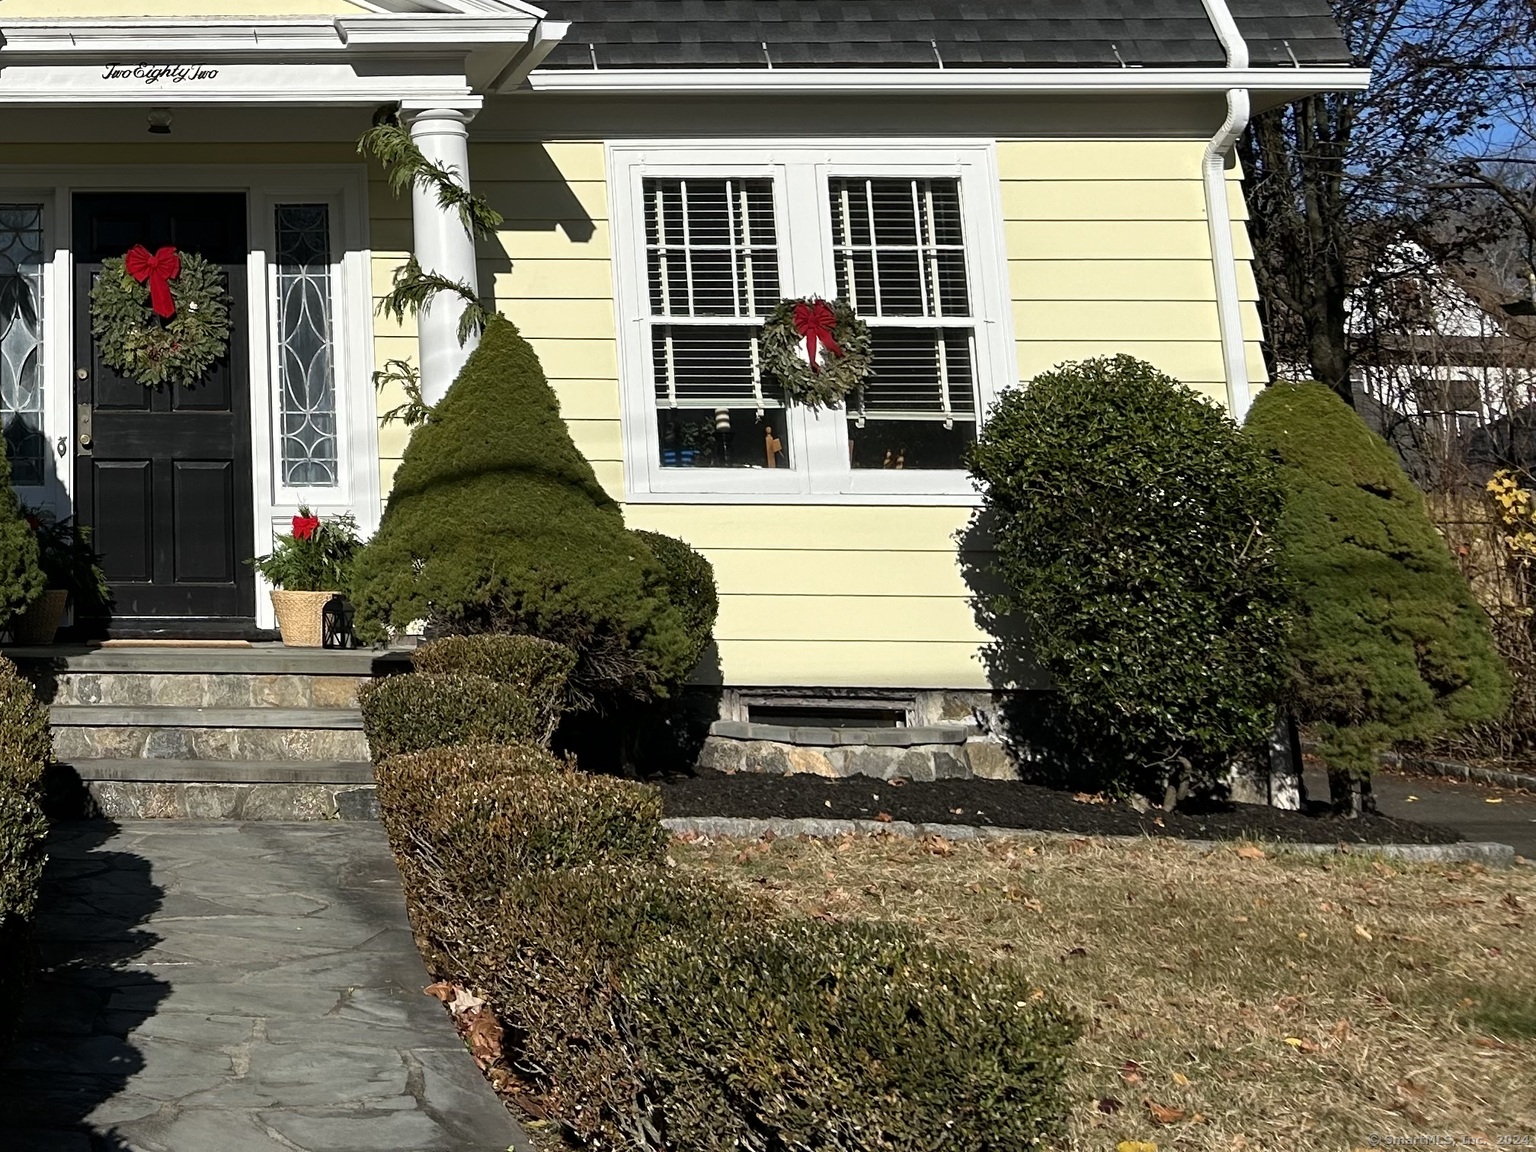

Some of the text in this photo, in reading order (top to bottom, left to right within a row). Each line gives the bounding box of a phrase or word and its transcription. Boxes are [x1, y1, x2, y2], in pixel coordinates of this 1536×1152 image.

[102, 62, 219, 84] Two Eighty Two
